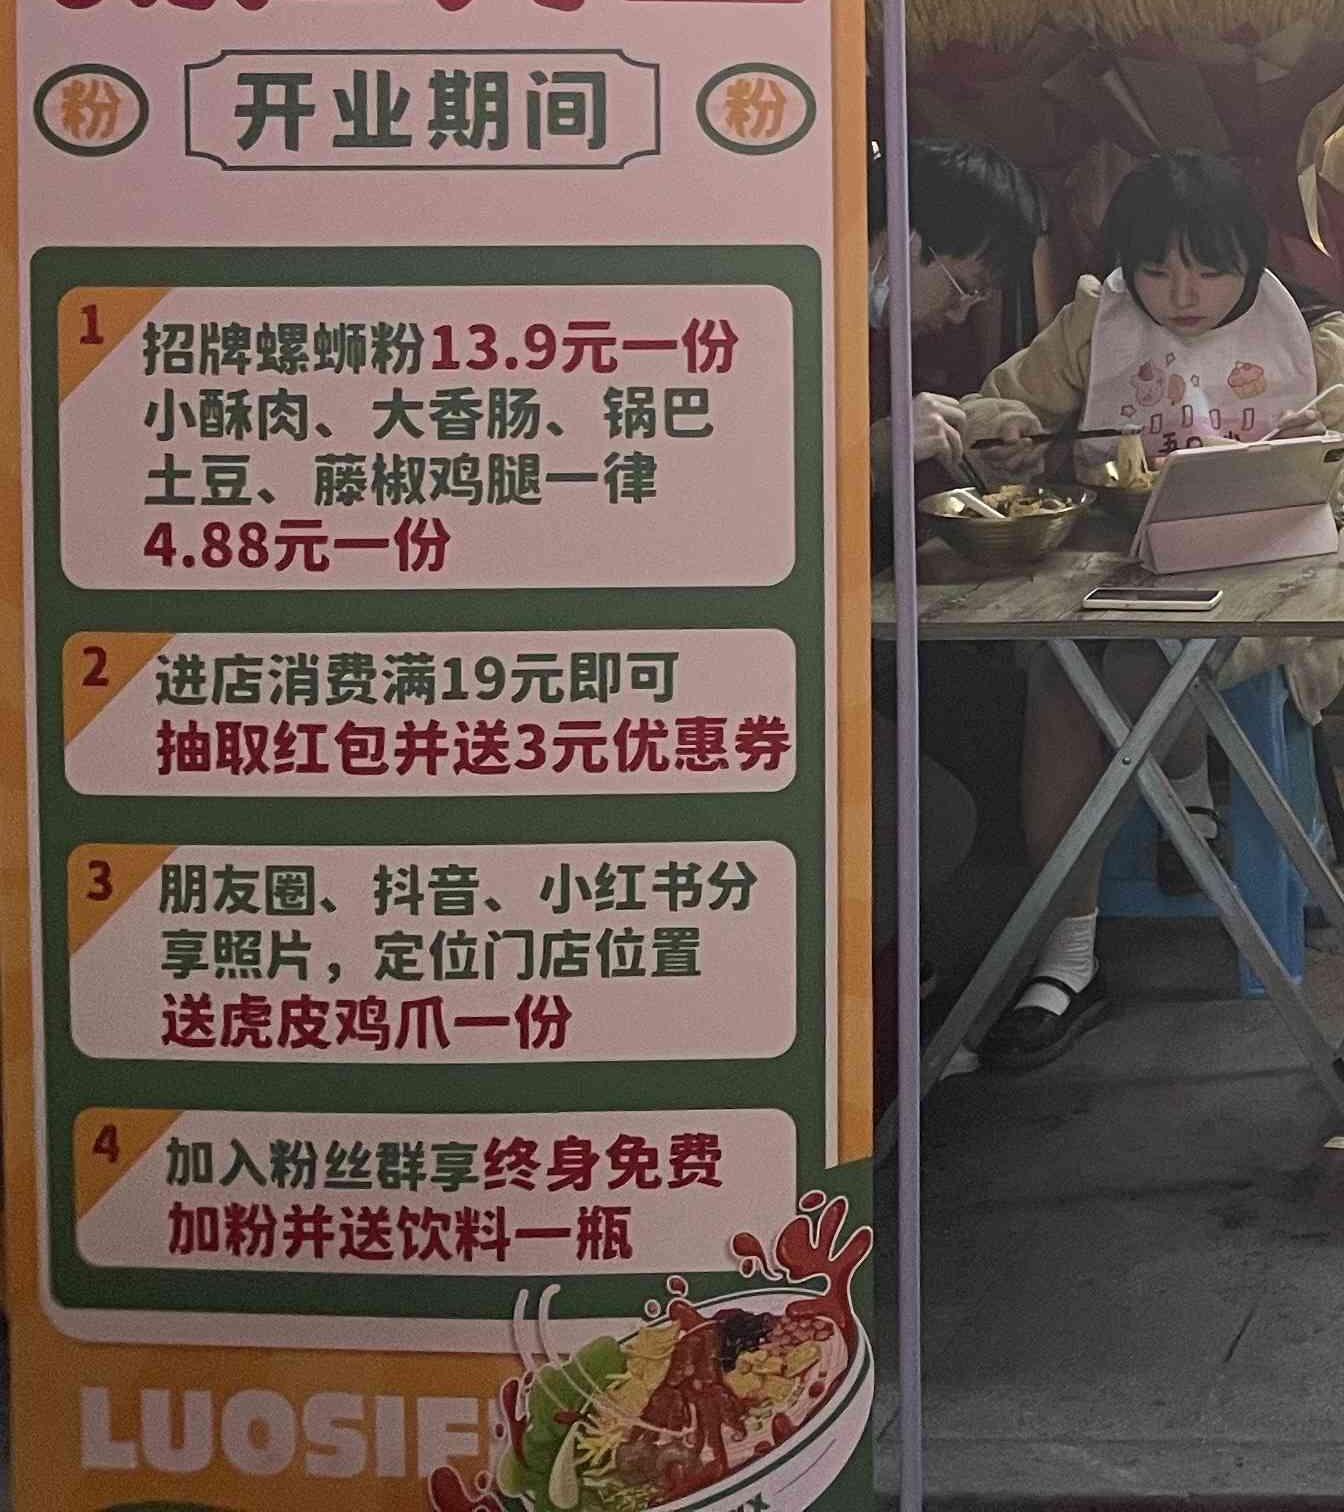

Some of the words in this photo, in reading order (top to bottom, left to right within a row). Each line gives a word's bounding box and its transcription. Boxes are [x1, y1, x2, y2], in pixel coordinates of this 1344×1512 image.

[58, 77, 124, 140] 粉
[233, 69, 607, 152] 开业期间
[723, 77, 789, 140] 粉
[79, 304, 105, 346] 1
[142, 317, 740, 377] 招牌螺蛳粉13.9元一份
[142, 386, 715, 443] 小酥肉、大香肠、锅巴
[142, 451, 658, 509] 土豆、藤椒鸡腿一律
[142, 516, 452, 572] 4.88元一份
[82, 645, 109, 687] 2
[154, 650, 680, 708] 进店消费满19元即可
[155, 716, 793, 777] 抽取红包并送3元优惠券
[86, 860, 114, 902] 3
[158, 859, 759, 917] 朋友圈、抖音、小红书分
[160, 928, 702, 983] 享照片，定位门店位置
[160, 994, 573, 1051] 送虎皮鸡爪一份
[92, 1125, 119, 1165] 4
[166, 1133, 724, 1193] 加入粉丝群享终身免费
[168, 1203, 634, 1264] 加粉并送饮料一瓶
